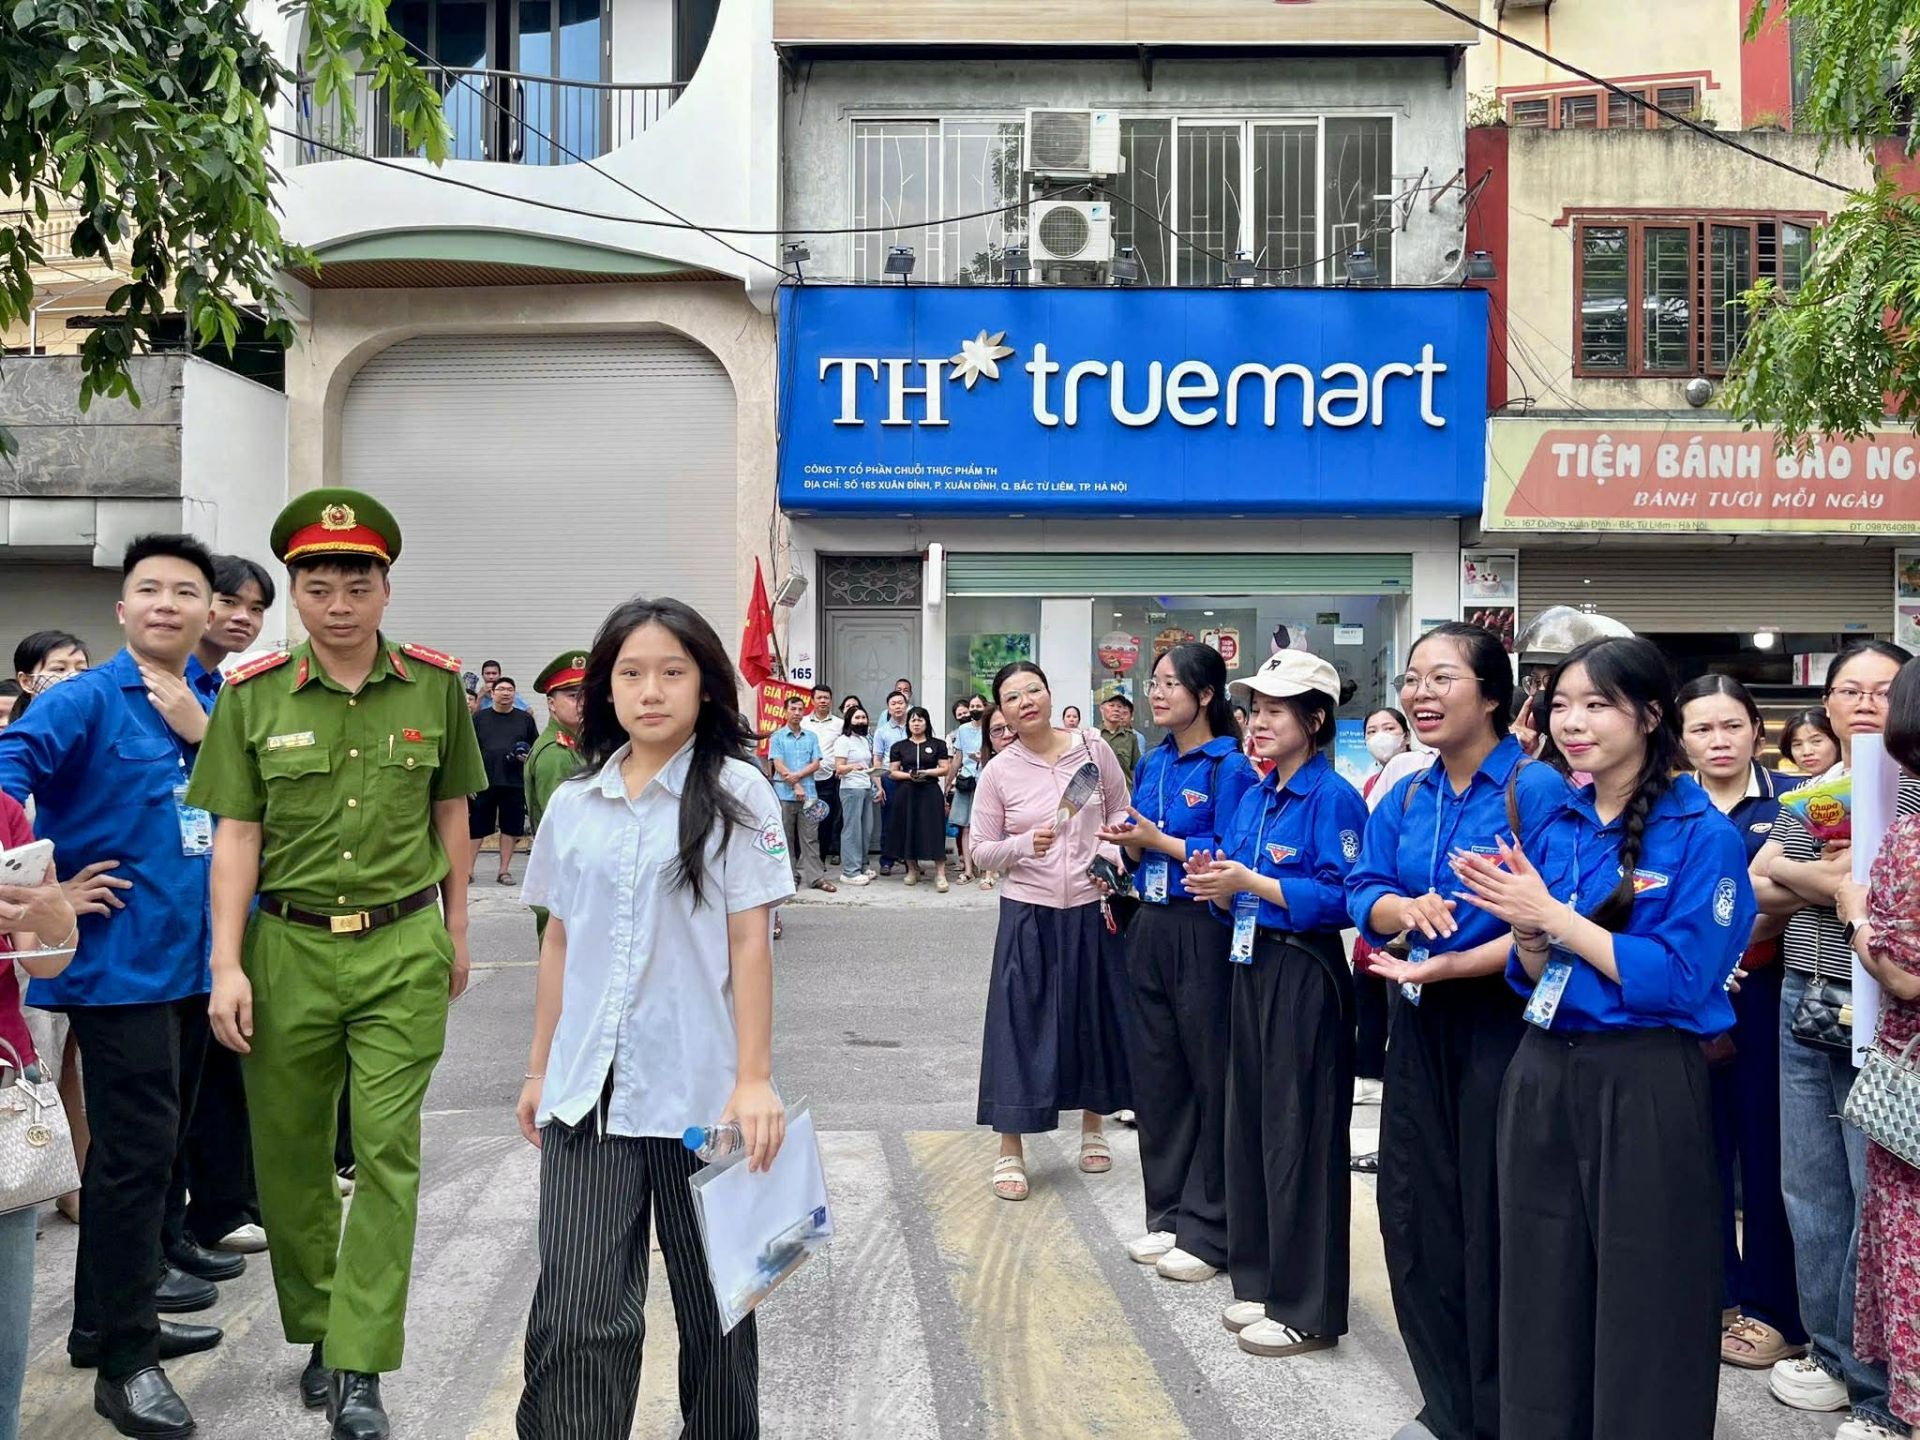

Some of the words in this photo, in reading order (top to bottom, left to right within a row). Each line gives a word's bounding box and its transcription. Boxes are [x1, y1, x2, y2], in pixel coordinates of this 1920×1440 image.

[819, 356, 950, 426] TH
[1025, 342, 1448, 428] truemart
[1551, 433, 1641, 486] TIỆM
[1656, 435, 1761, 479] BÁNH
[1866, 445, 1920, 480] NG
[804, 464, 833, 475] CÔNG
[835, 466, 847, 474] TY
[849, 462, 864, 475] CỔ
[865, 462, 892, 475] PHẦN
[894, 462, 925, 475] CHUỖI
[927, 465, 952, 477] THỰC
[955, 463, 982, 476] PHẨM
[985, 466, 998, 476] TH
[804, 480, 820, 490] ĐỊA
[844, 478, 859, 489] SỐ
[861, 481, 876, 489] 165
[878, 479, 904, 490] XUÂN
[944, 480, 971, 490] XUÂN
[1013, 479, 1034, 491] BẮC
[1094, 480, 1108, 491] HÀ
[1110, 480, 1128, 494] NỘI
[1633, 488, 1697, 507] BÁNH
[1708, 490, 1763, 508] TƯƠI
[1772, 487, 1817, 508] MỖI
[1825, 490, 1885, 509] NGÀY
[791, 668, 812, 679] 165
[764, 685, 782, 700] GIA
[1810, 802, 1838, 812] Chupa
[1811, 810, 1839, 823] Chups
